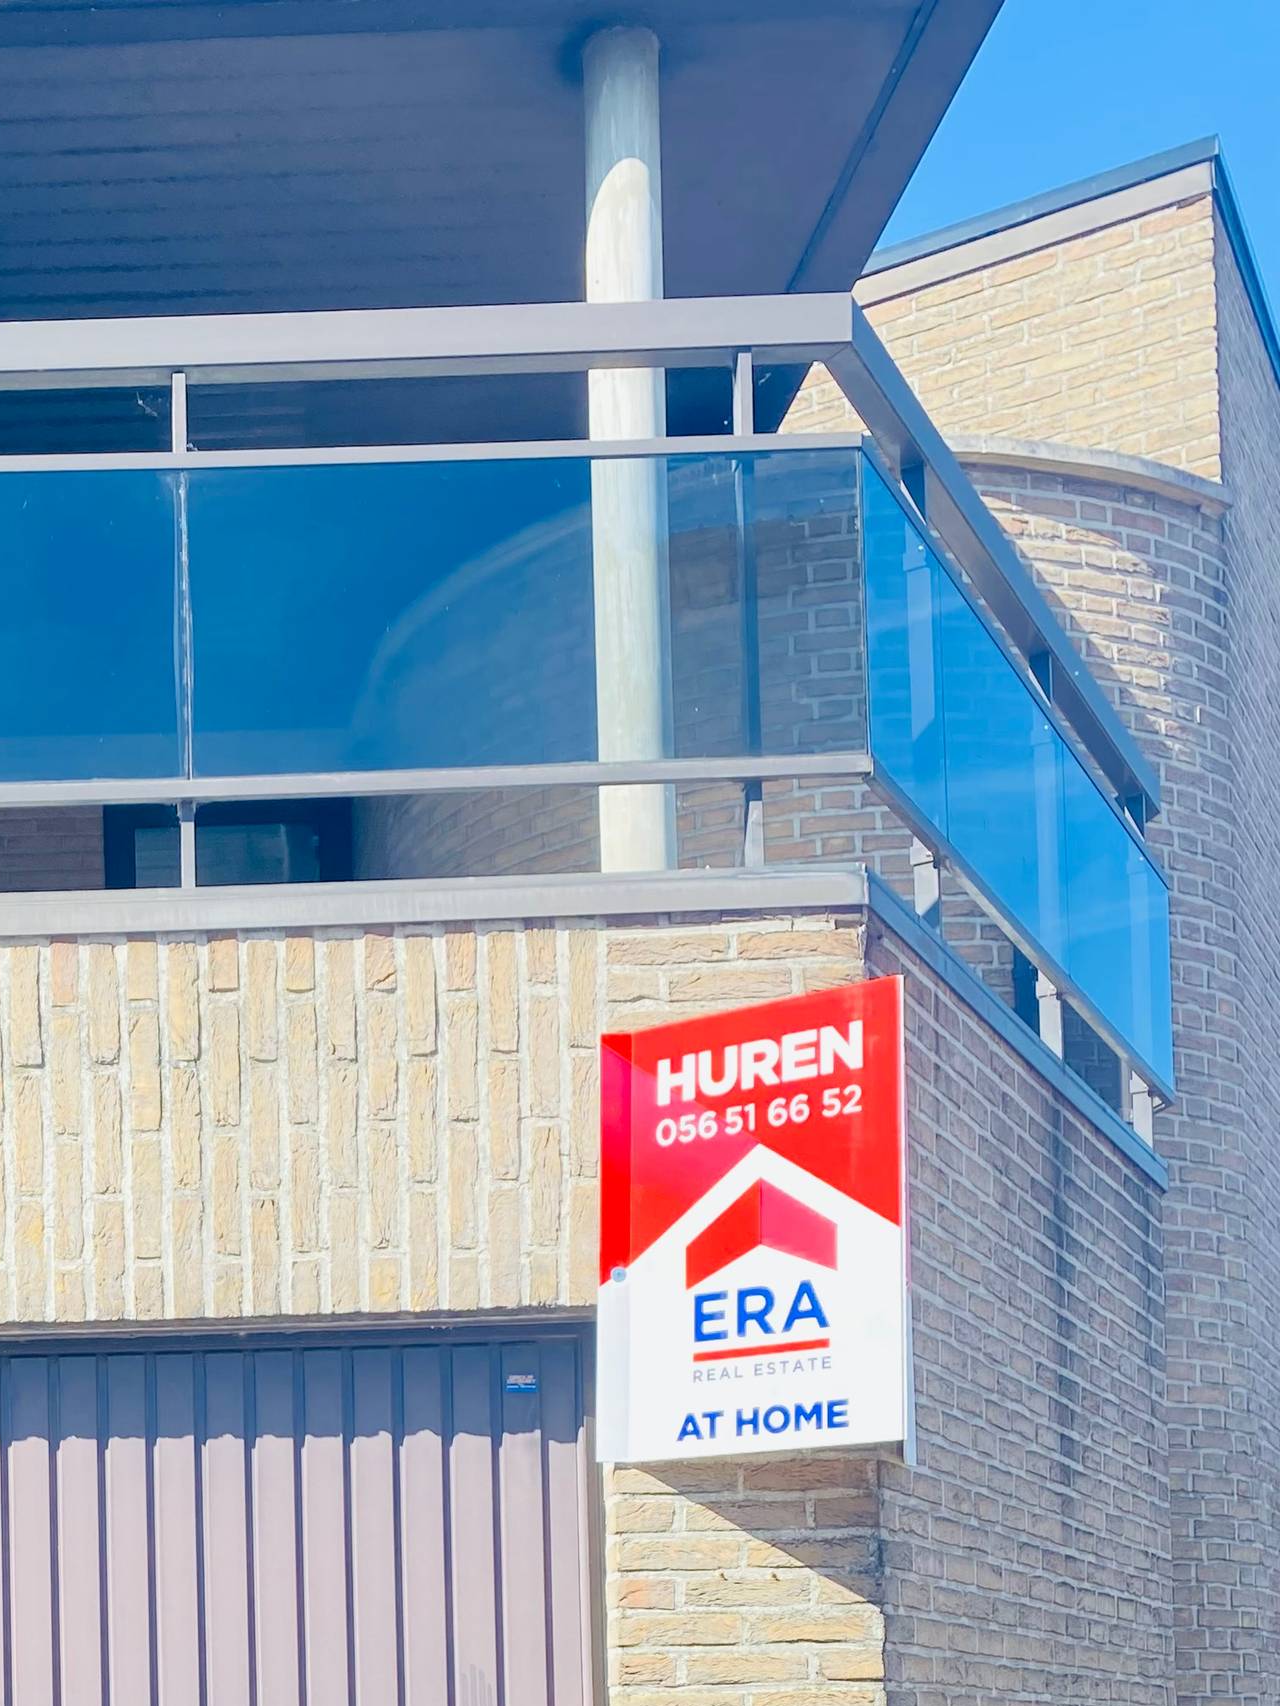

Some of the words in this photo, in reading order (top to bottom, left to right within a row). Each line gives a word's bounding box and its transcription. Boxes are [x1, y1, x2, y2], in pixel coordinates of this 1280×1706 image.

[656, 1020, 864, 1106] HUREN
[655, 1111, 718, 1147] 056
[724, 1102, 756, 1136] 51
[766, 1093, 810, 1129] 66
[821, 1084, 863, 1118] 52
[693, 1279, 831, 1343] ERA
[692, 1365, 744, 1383] REAL
[753, 1356, 832, 1377] ESTATE
[676, 1410, 724, 1442] AT
[735, 1398, 850, 1438] HOME
